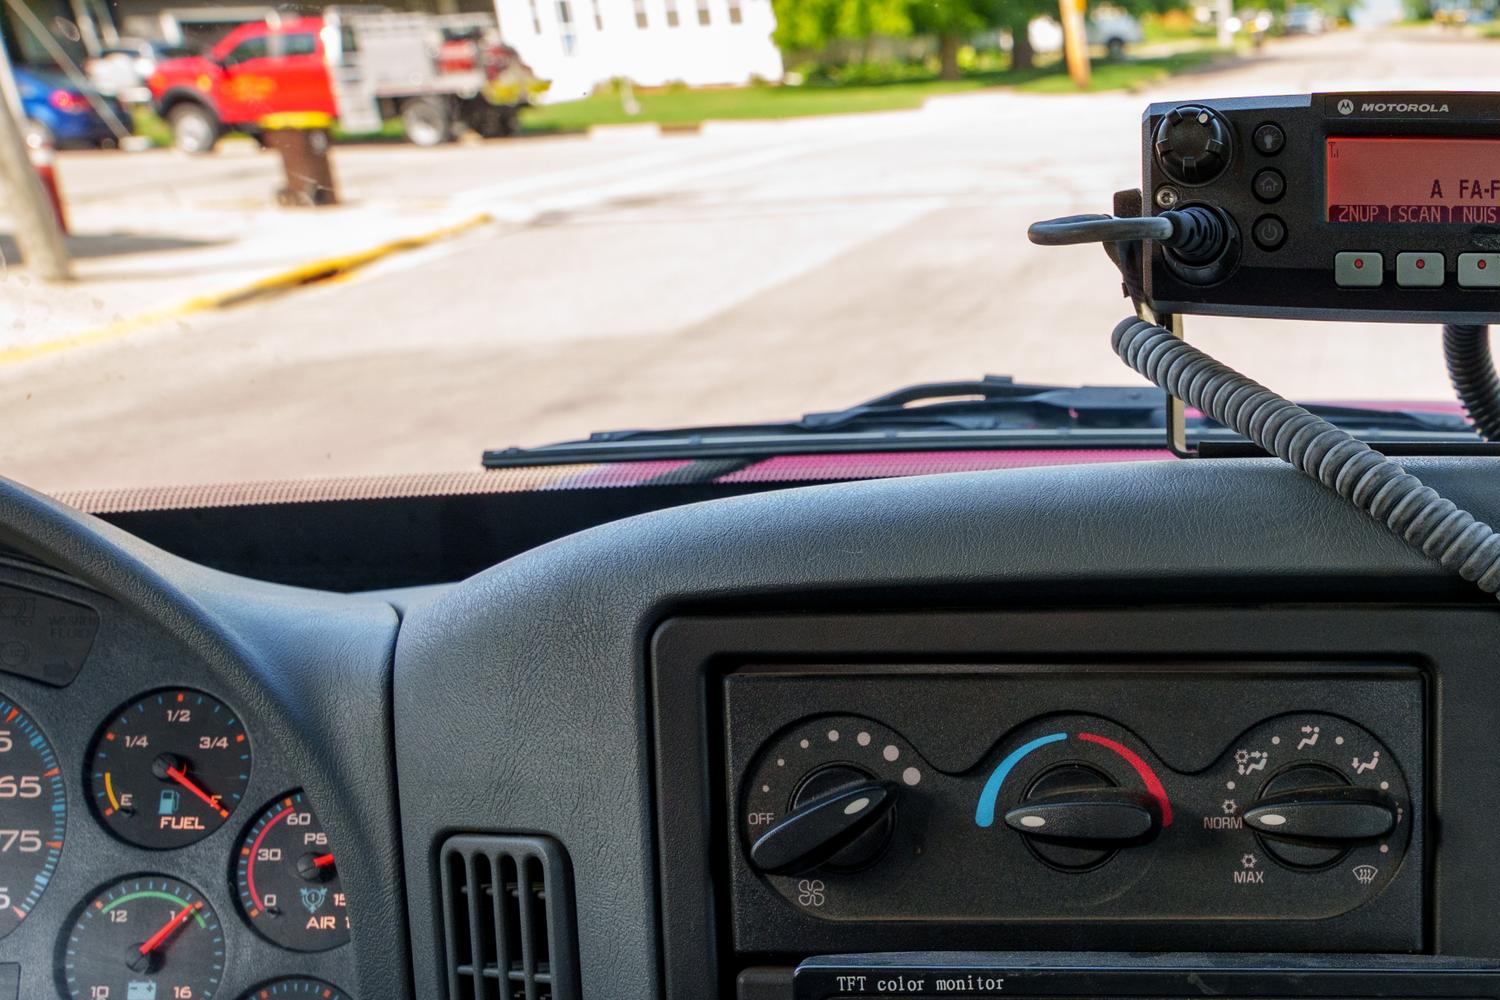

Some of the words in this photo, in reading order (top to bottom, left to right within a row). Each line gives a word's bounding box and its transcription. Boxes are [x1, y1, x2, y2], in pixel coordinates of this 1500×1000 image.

[1361, 103, 1449, 113] MOTOROLA
[1430, 179, 1443, 198] A
[1399, 206, 1441, 223] SCAN
[1463, 206, 1497, 223] NUIS
[166, 709, 191, 722] 1/2
[124, 736, 149, 748] 1/4
[199, 736, 229, 749] 3/4
[0, 776, 42, 798] 65
[121, 794, 133, 807] E
[160, 816, 205, 830] FUEL
[287, 813, 311, 825] 60
[748, 812, 775, 826] OFF
[1203, 816, 1243, 829] NORM
[0, 830, 42, 852] 75
[258, 849, 281, 861] 30
[1233, 871, 1264, 883] MAX
[264, 895, 277, 906] 0
[110, 911, 128, 922] 12
[306, 916, 336, 929] AIR
[836, 976, 867, 992] TFT
[877, 976, 925, 992] color
[935, 975, 1004, 991] monitor
[90, 986, 110, 998] 10
[174, 986, 192, 998] 16
